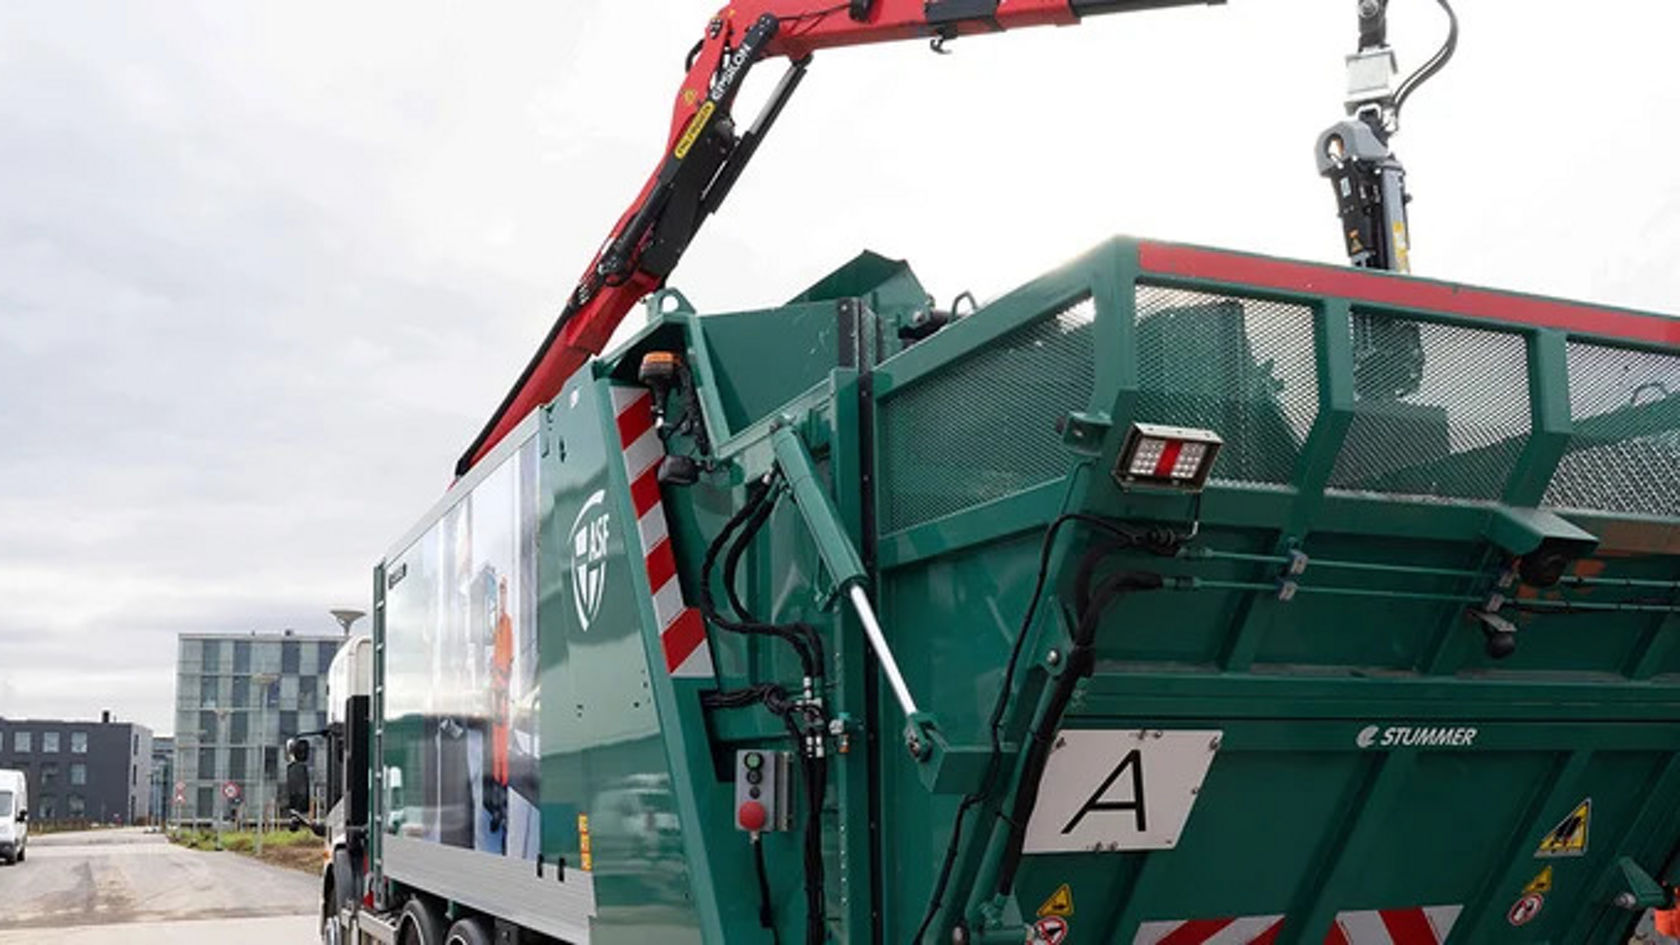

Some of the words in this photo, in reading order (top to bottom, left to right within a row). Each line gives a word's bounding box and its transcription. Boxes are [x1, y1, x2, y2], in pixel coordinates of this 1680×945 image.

[711, 43, 751, 101] EPSILON
[588, 513, 609, 562] ASF
[1381, 727, 1478, 745] STUMMER
[1061, 749, 1146, 834] A
